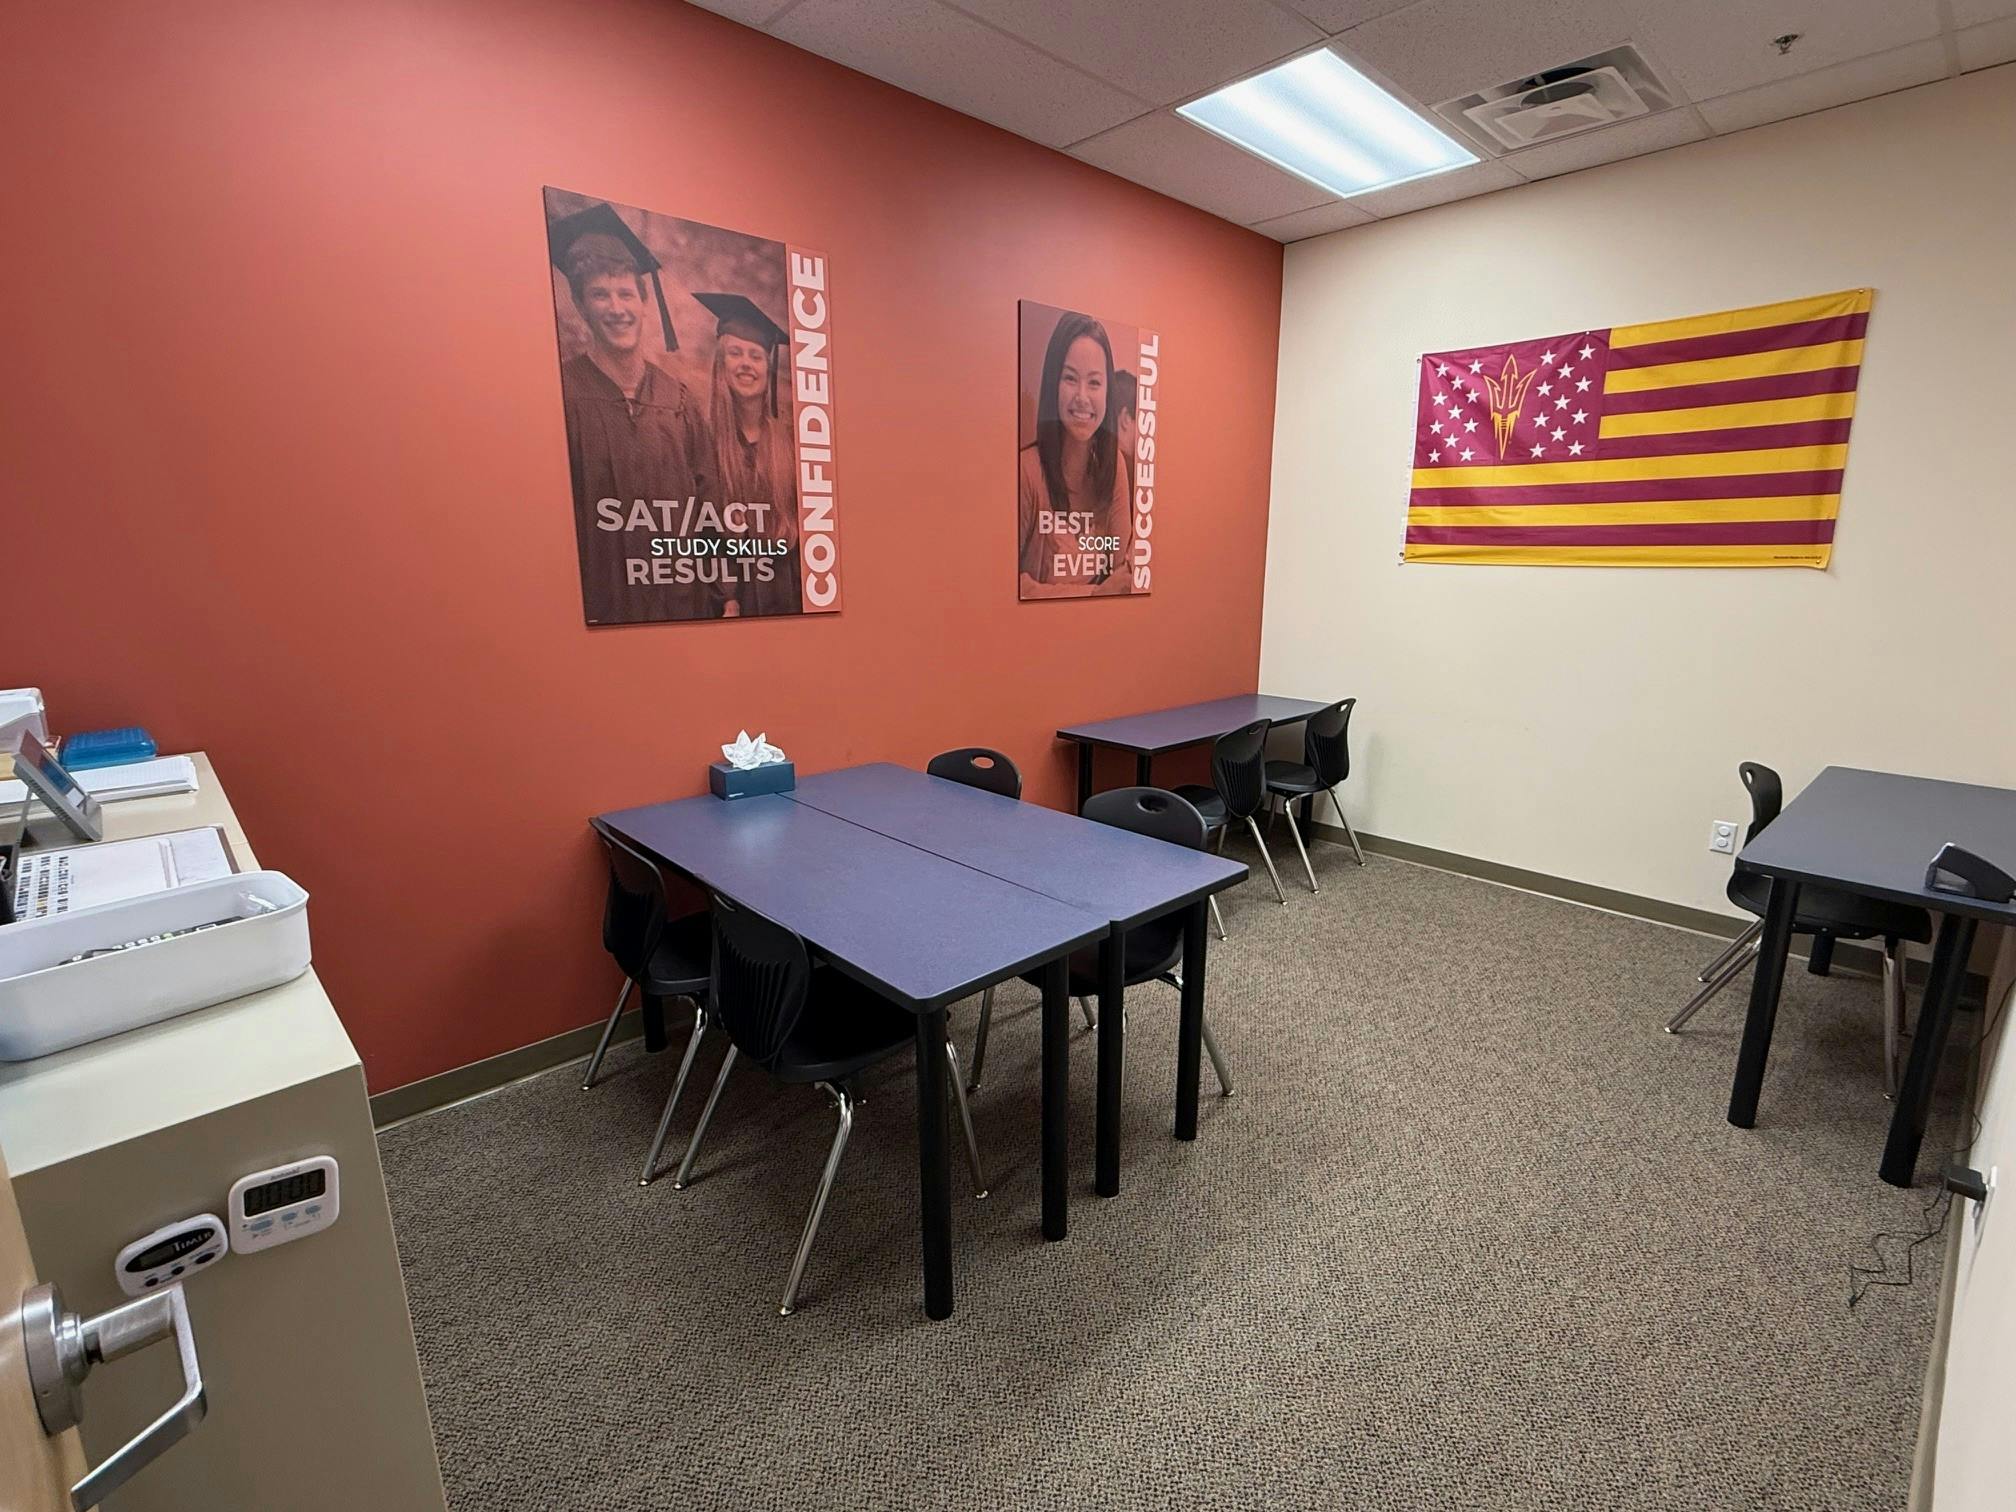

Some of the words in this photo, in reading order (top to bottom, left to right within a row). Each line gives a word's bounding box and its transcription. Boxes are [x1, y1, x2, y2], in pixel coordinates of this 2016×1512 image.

[791, 251, 837, 608] CONFIDENCE
[1133, 334, 1159, 590] SUCCESSFUL
[596, 496, 771, 537] SAT/ACT
[1038, 510, 1094, 535] BEST
[650, 538, 721, 556] STUDY
[726, 538, 788, 556] SKILLS
[1078, 536, 1120, 551] SCORE
[625, 557, 776, 585] RESULTS
[1053, 553, 1114, 577] EVER!
